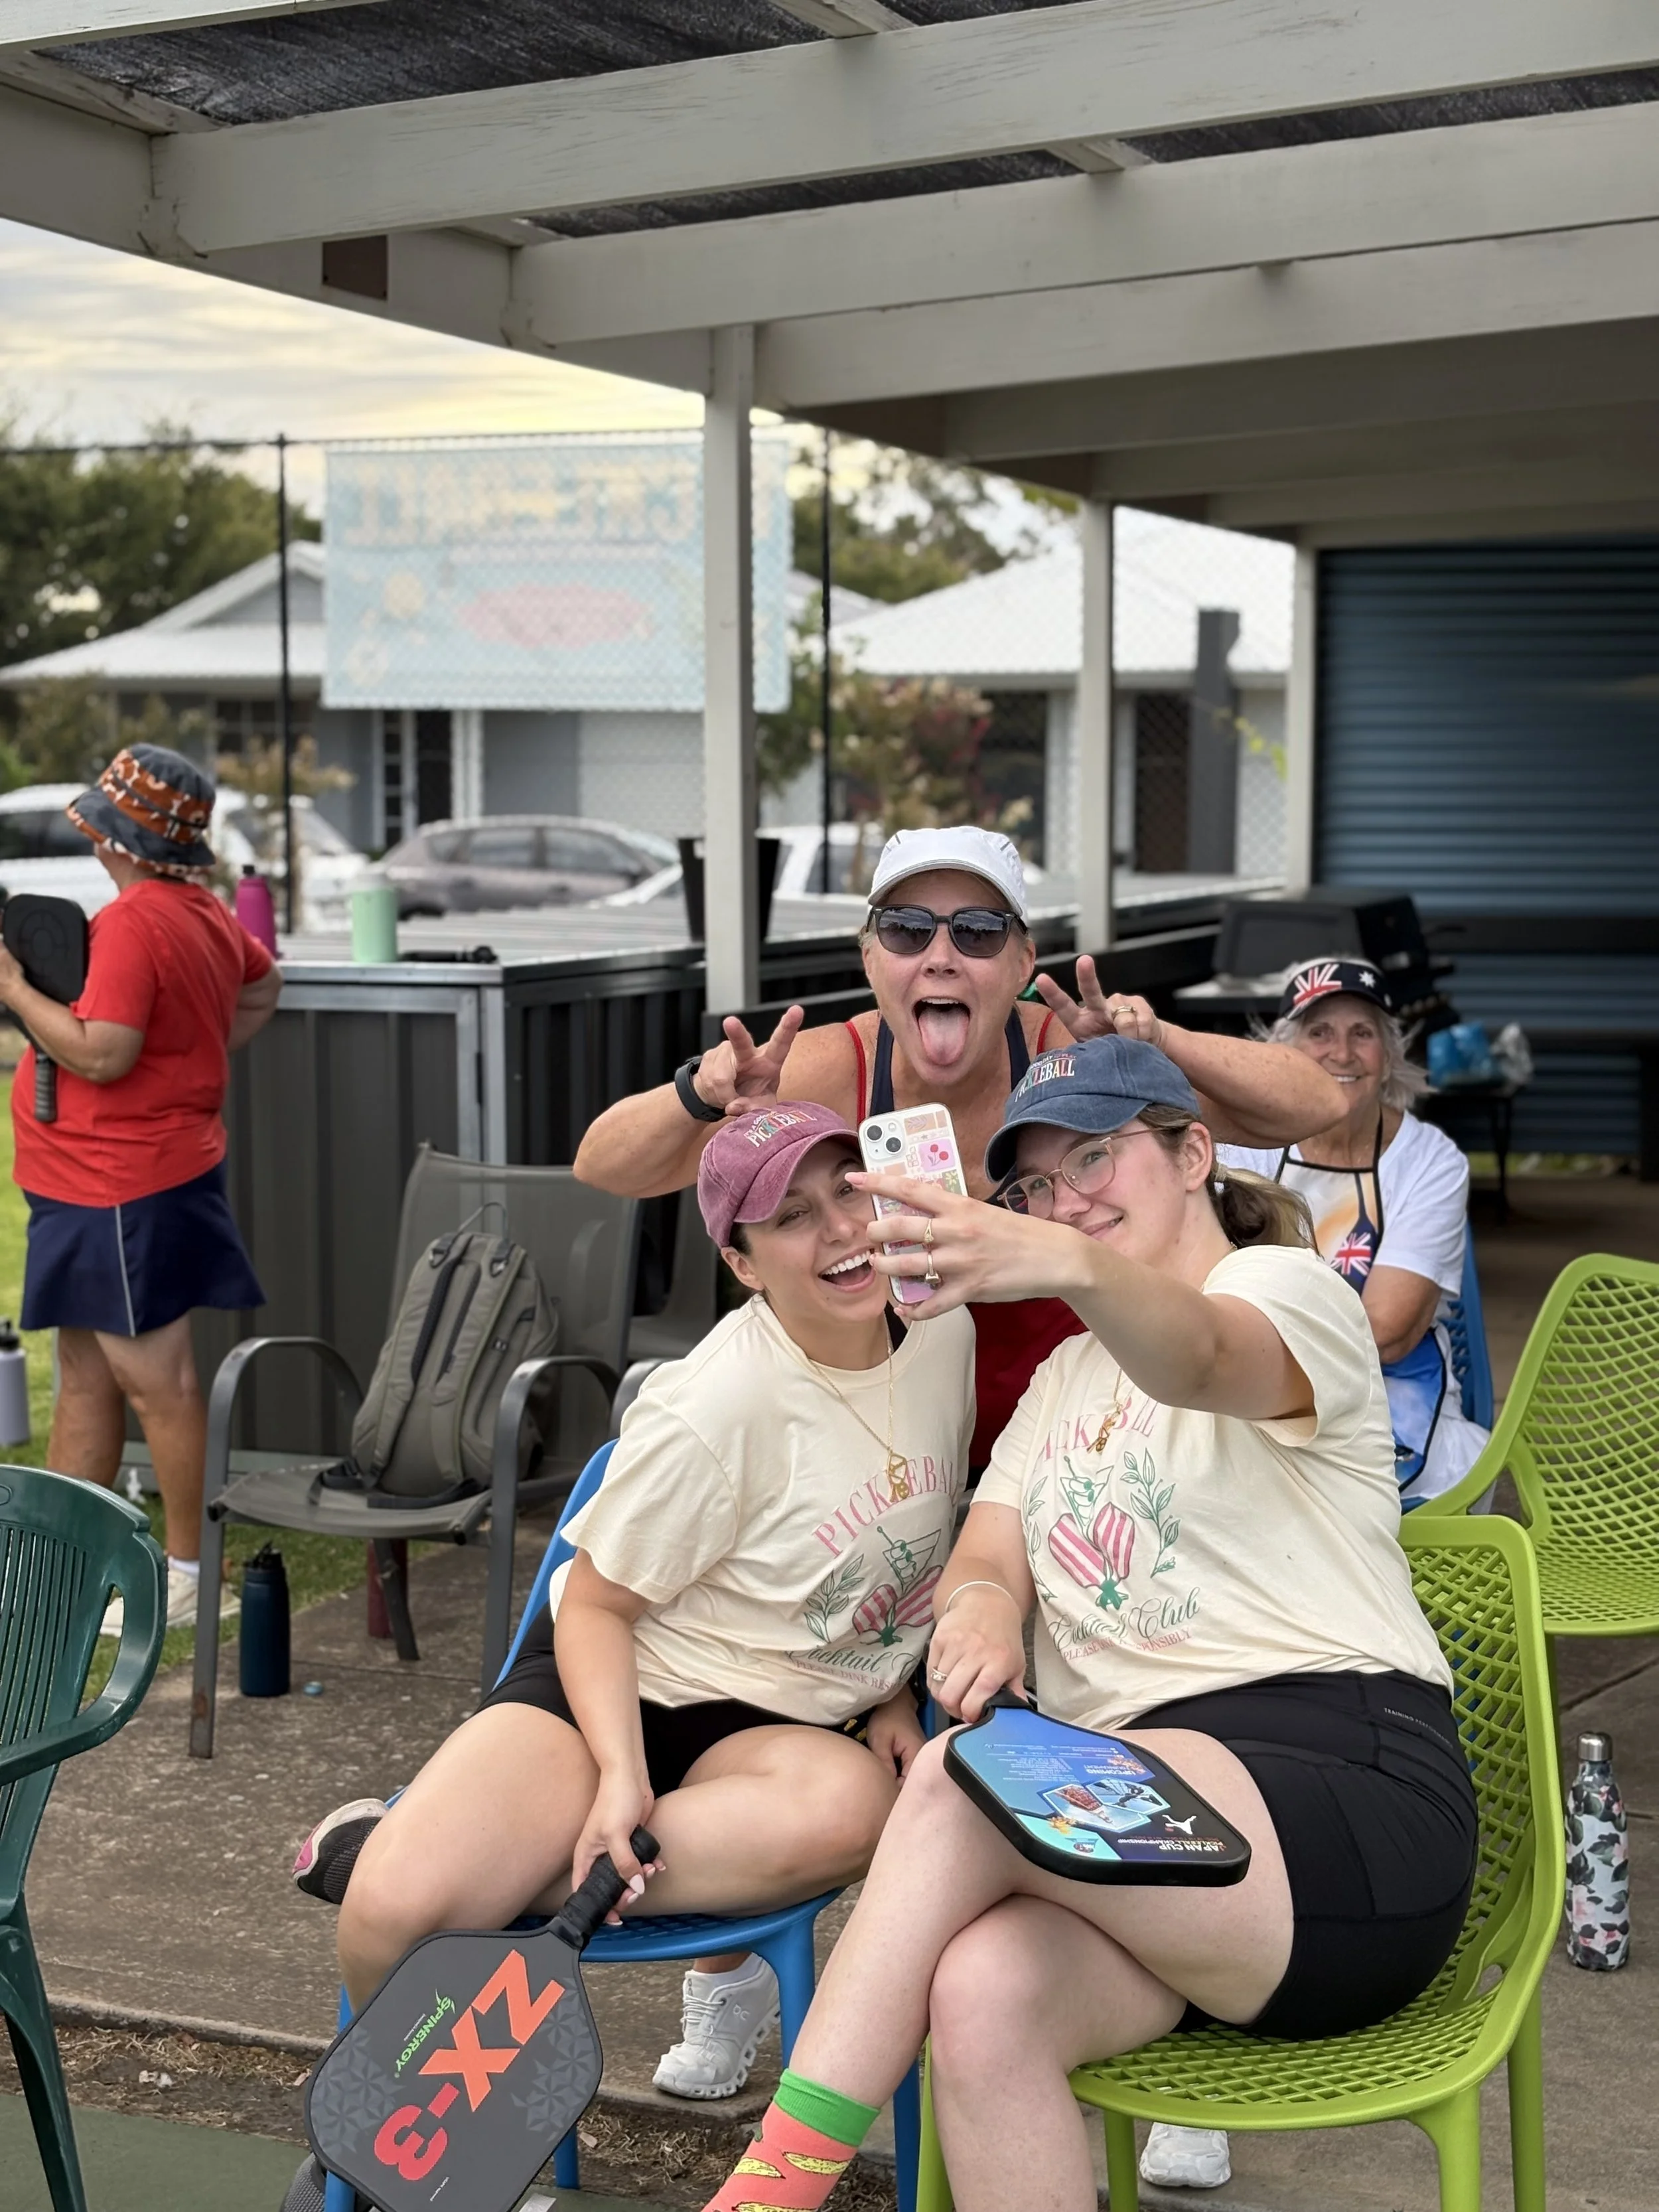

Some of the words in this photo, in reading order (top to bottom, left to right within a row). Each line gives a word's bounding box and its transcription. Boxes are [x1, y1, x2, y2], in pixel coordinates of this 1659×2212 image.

[1129, 1587, 1200, 1645] Club
[1119, 1627, 1192, 1652] SPONSIBLY
[1384, 1707, 1414, 1721] TRAINING
[1184, 1843, 1226, 1852] JAPAN
[396, 1990, 455, 2072] SPINERGY
[374, 1950, 565, 2181] ZX-3
